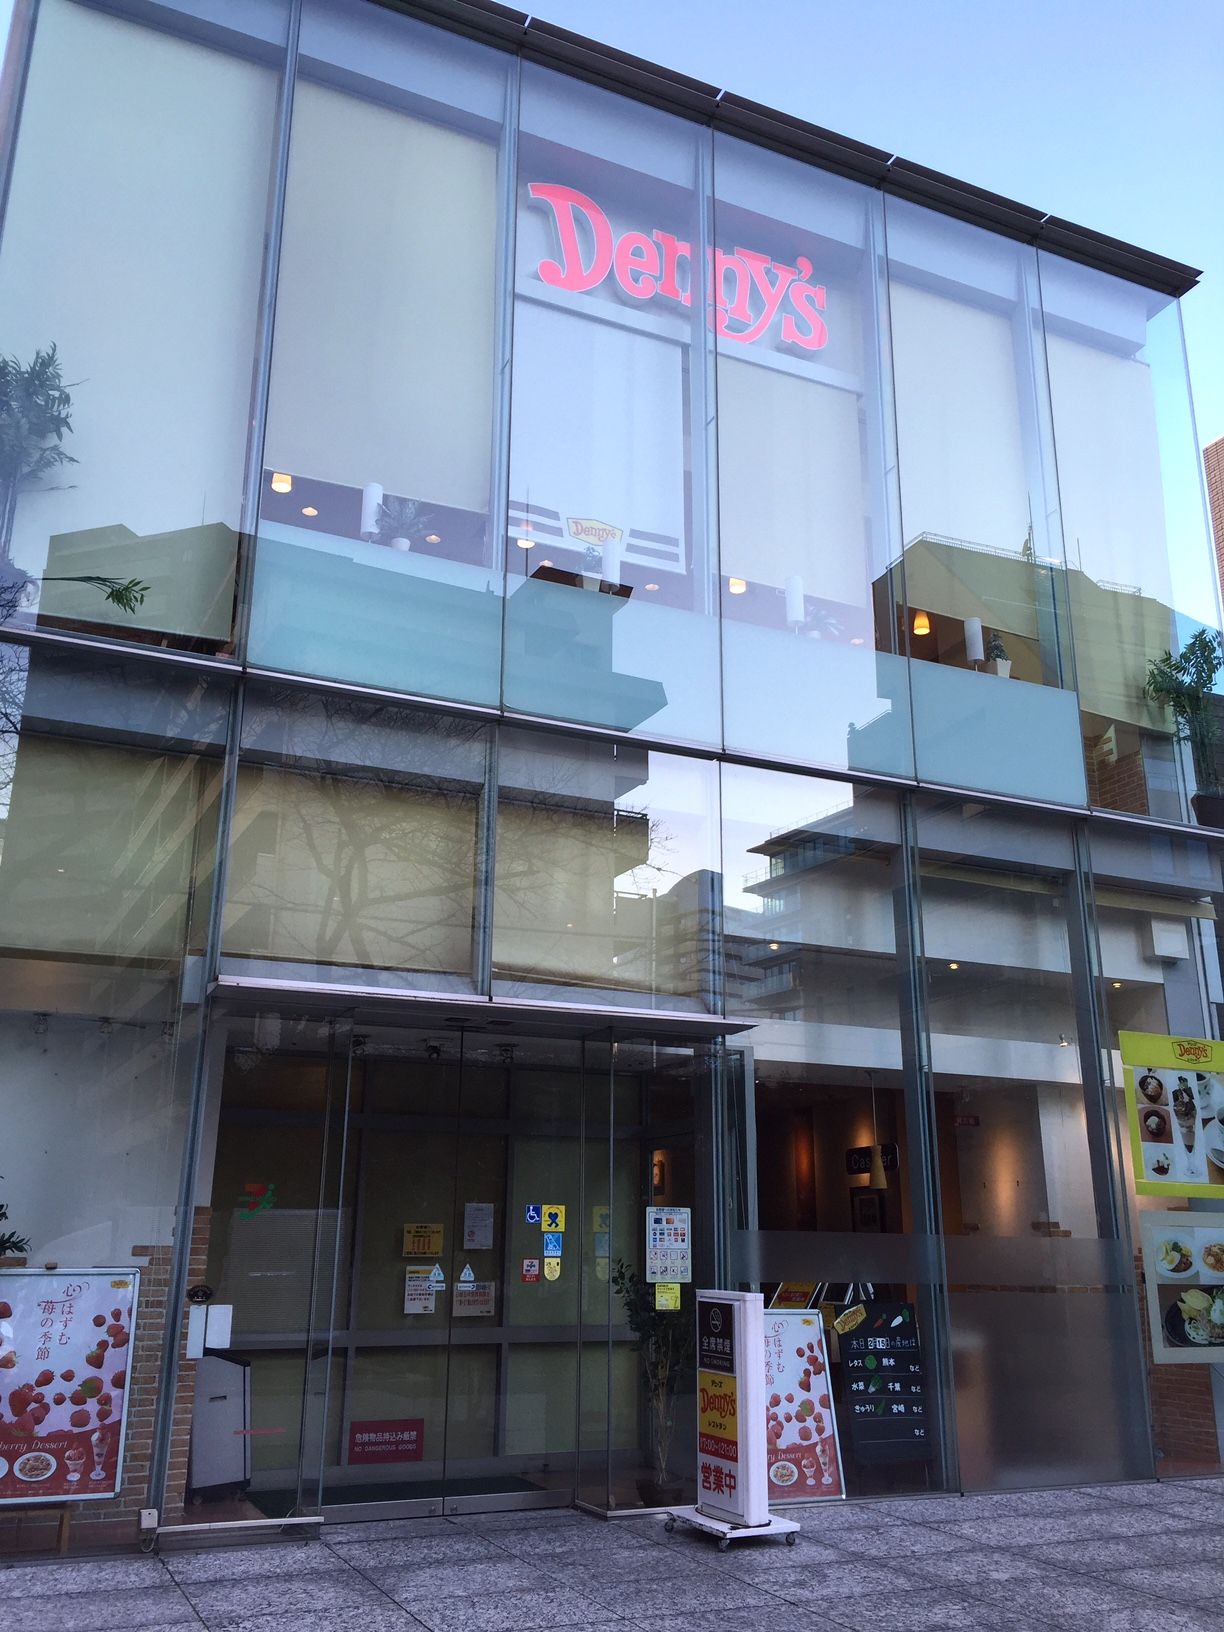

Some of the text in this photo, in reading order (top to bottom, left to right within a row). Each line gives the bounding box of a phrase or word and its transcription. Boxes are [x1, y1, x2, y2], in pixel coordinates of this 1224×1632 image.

[527, 182, 828, 350] Denny's
[572, 520, 617, 542] Denny's
[1178, 1043, 1208, 1060] Denny's
[848, 1360, 863, 1368] レタス
[700, 1388, 737, 1419] Denny's
[31, 1440, 68, 1450] Dessert
[701, 1461, 737, 1499] 営業中
